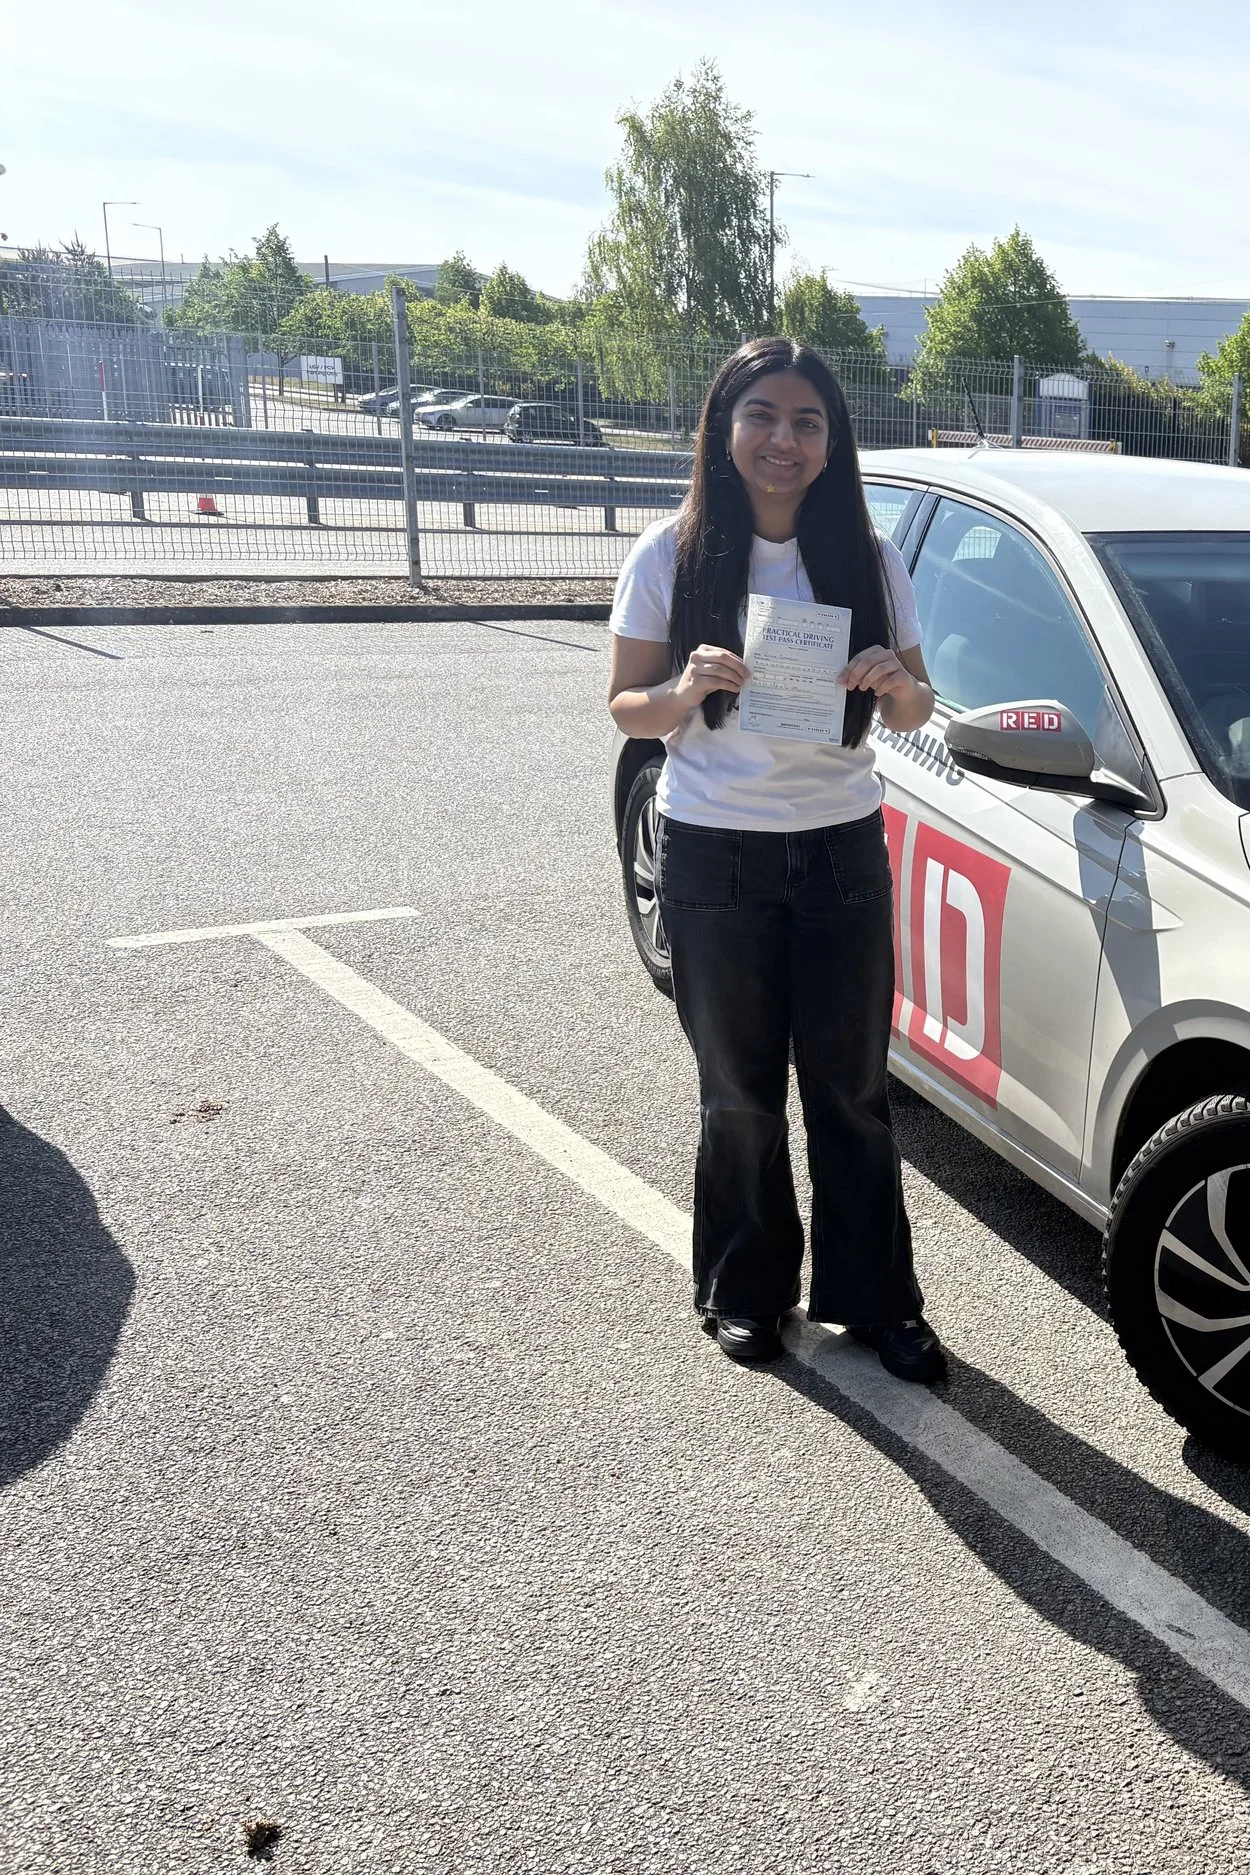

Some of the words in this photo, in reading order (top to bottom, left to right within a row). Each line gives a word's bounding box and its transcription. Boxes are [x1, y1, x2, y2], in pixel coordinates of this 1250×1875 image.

[778, 636, 794, 644] PASS
[795, 638, 834, 650] CERTIFICATE
[803, 632, 835, 643] DRIVING
[1002, 712, 1060, 730] RED
